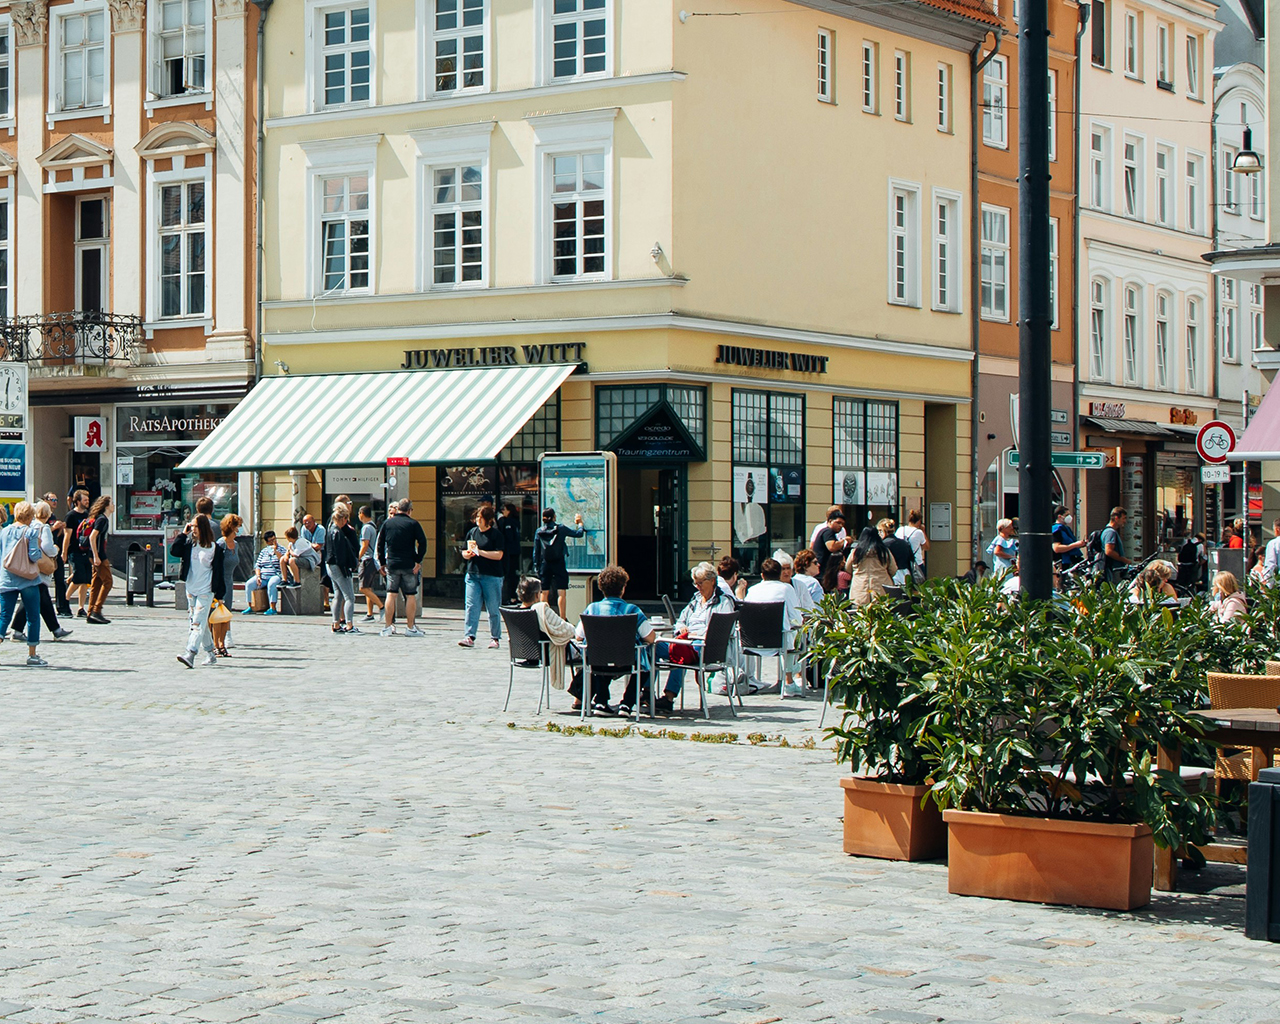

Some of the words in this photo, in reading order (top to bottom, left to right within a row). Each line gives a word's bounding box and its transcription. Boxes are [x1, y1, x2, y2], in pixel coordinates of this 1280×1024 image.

[401, 346, 518, 369] JUWELIER
[521, 342, 586, 364] WITT
[716, 344, 790, 370] JUWELIER
[790, 352, 829, 374] WITT
[617, 448, 689, 456] Trauringzentrum
[1203, 470, 1220, 478] 10-19
